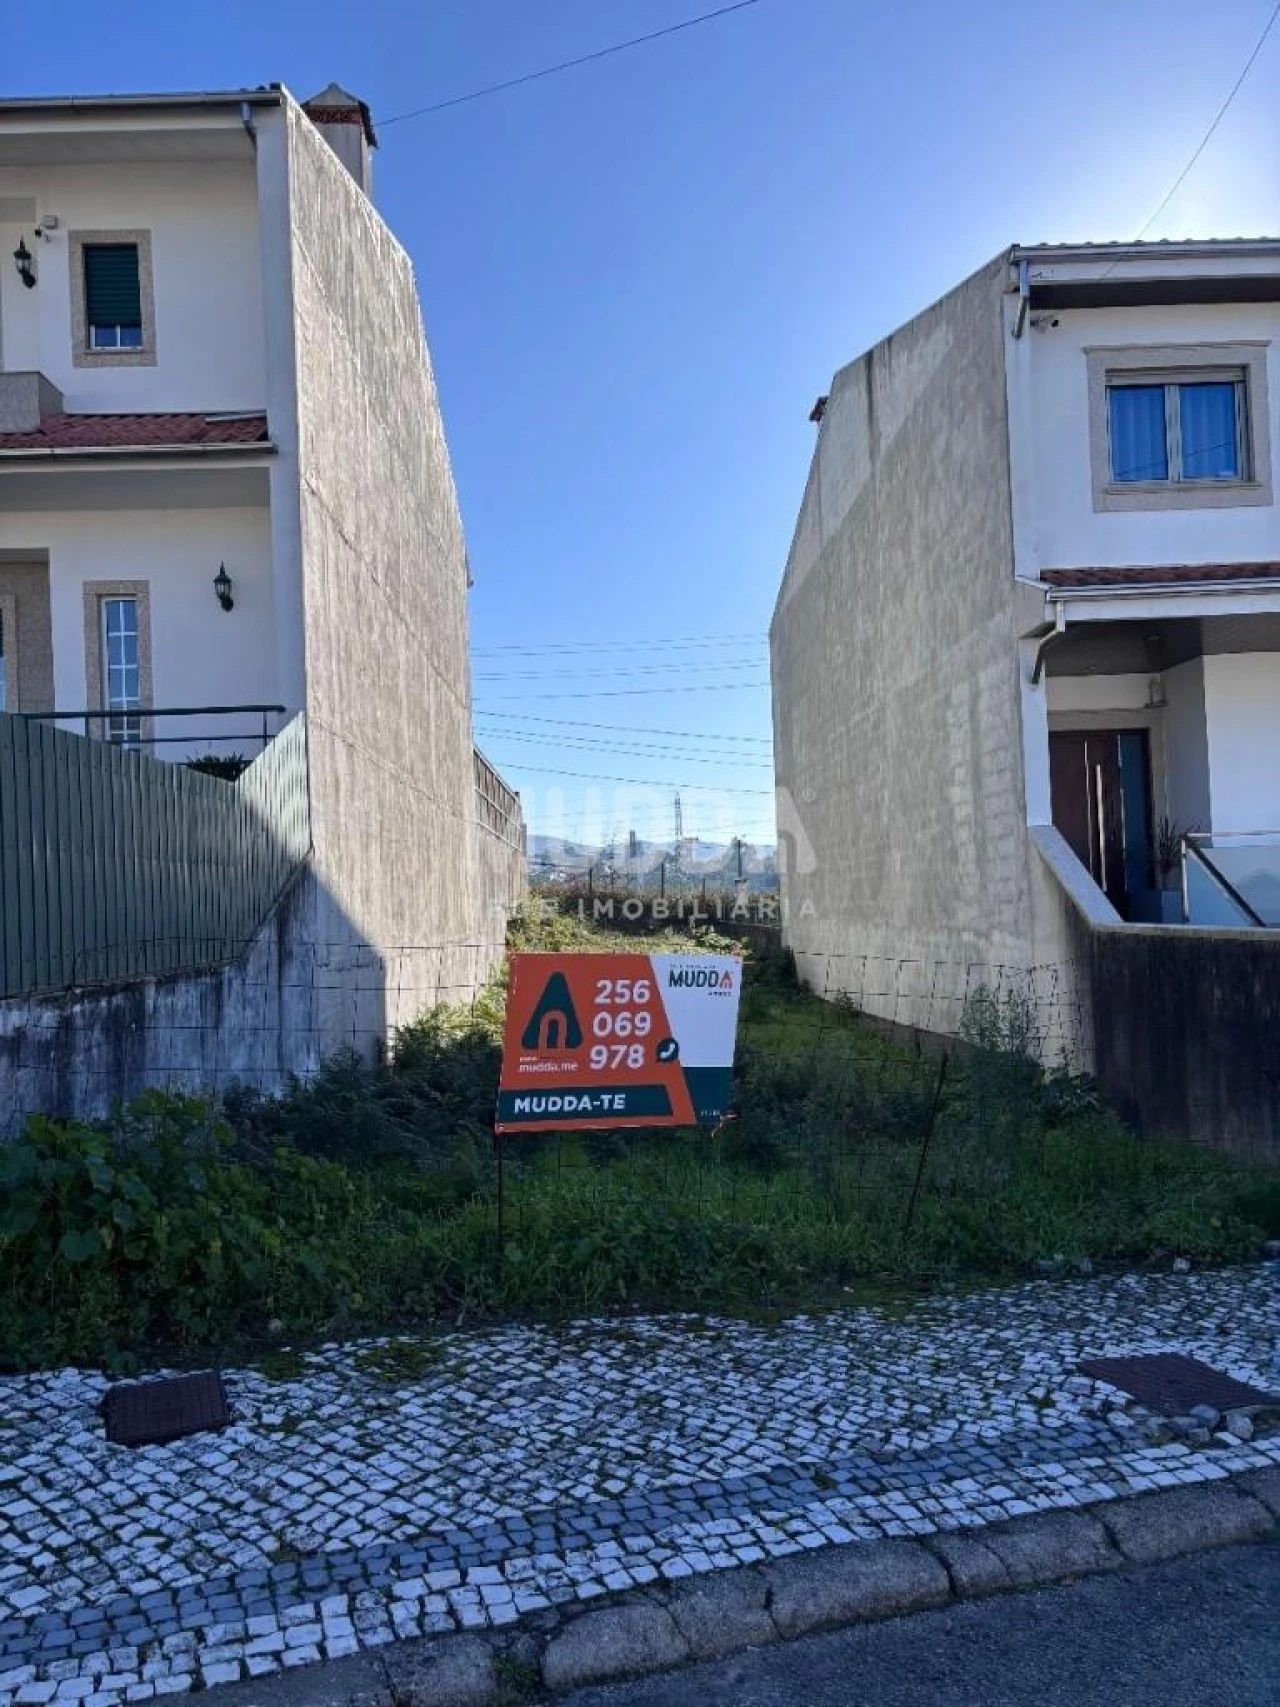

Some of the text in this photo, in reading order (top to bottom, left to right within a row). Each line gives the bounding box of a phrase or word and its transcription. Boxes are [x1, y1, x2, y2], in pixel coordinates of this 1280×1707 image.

[594, 979, 651, 1005] 256
[668, 969, 733, 989] MUDDA
[592, 1011, 651, 1038] 069
[589, 1044, 645, 1070] 978
[514, 1094, 626, 1114] MUDDA-TE
